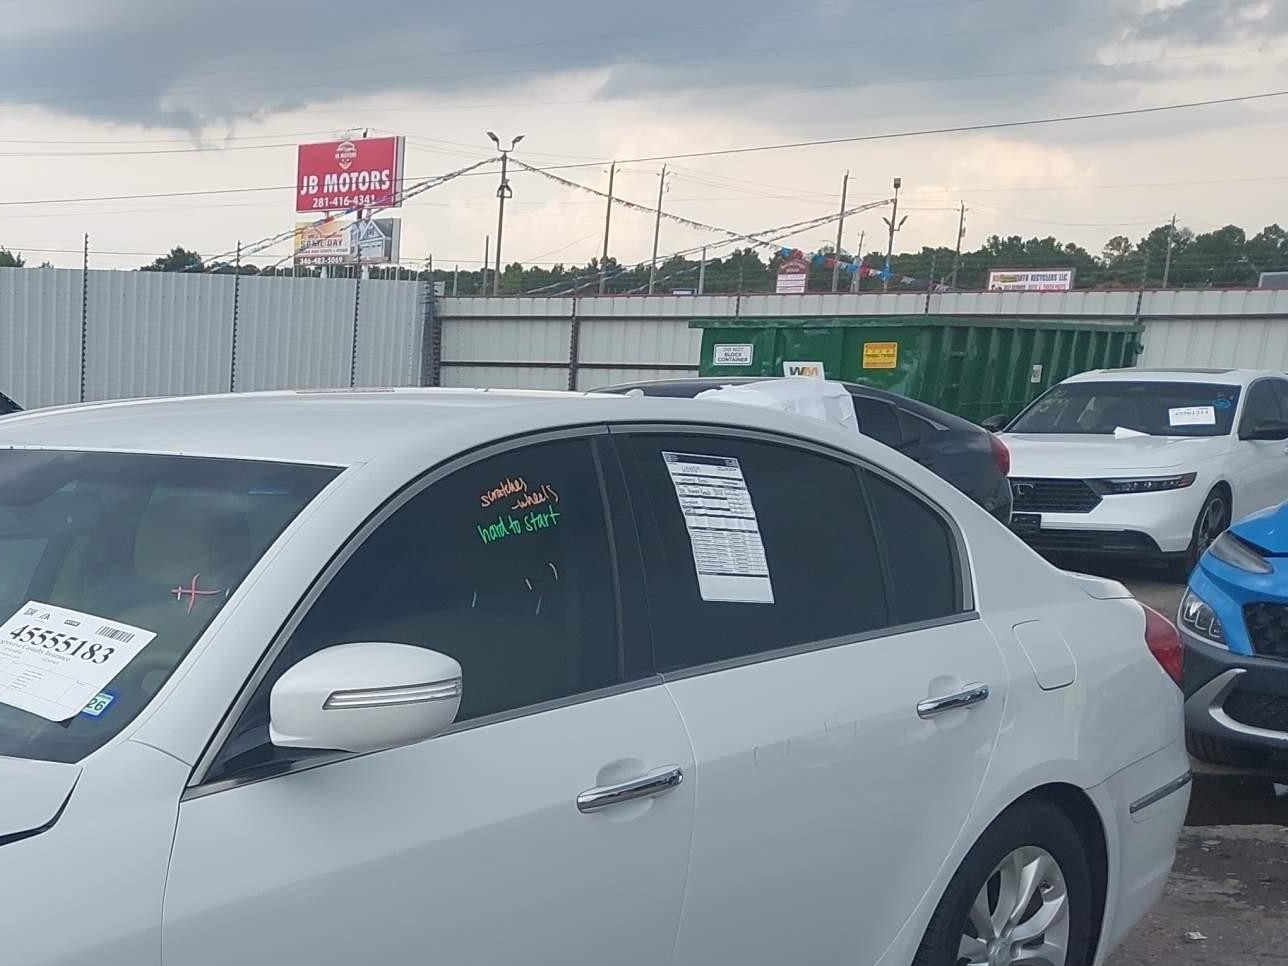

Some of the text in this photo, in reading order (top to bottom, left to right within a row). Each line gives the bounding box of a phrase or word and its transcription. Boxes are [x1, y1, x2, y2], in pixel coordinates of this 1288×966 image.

[300, 169, 391, 196] JB MOTORS
[312, 194, 376, 208] 281-416-4341
[789, 366, 820, 377] WM
[477, 504, 561, 544] hard to start
[9, 624, 115, 664] 45555183
[87, 697, 106, 711] 26
